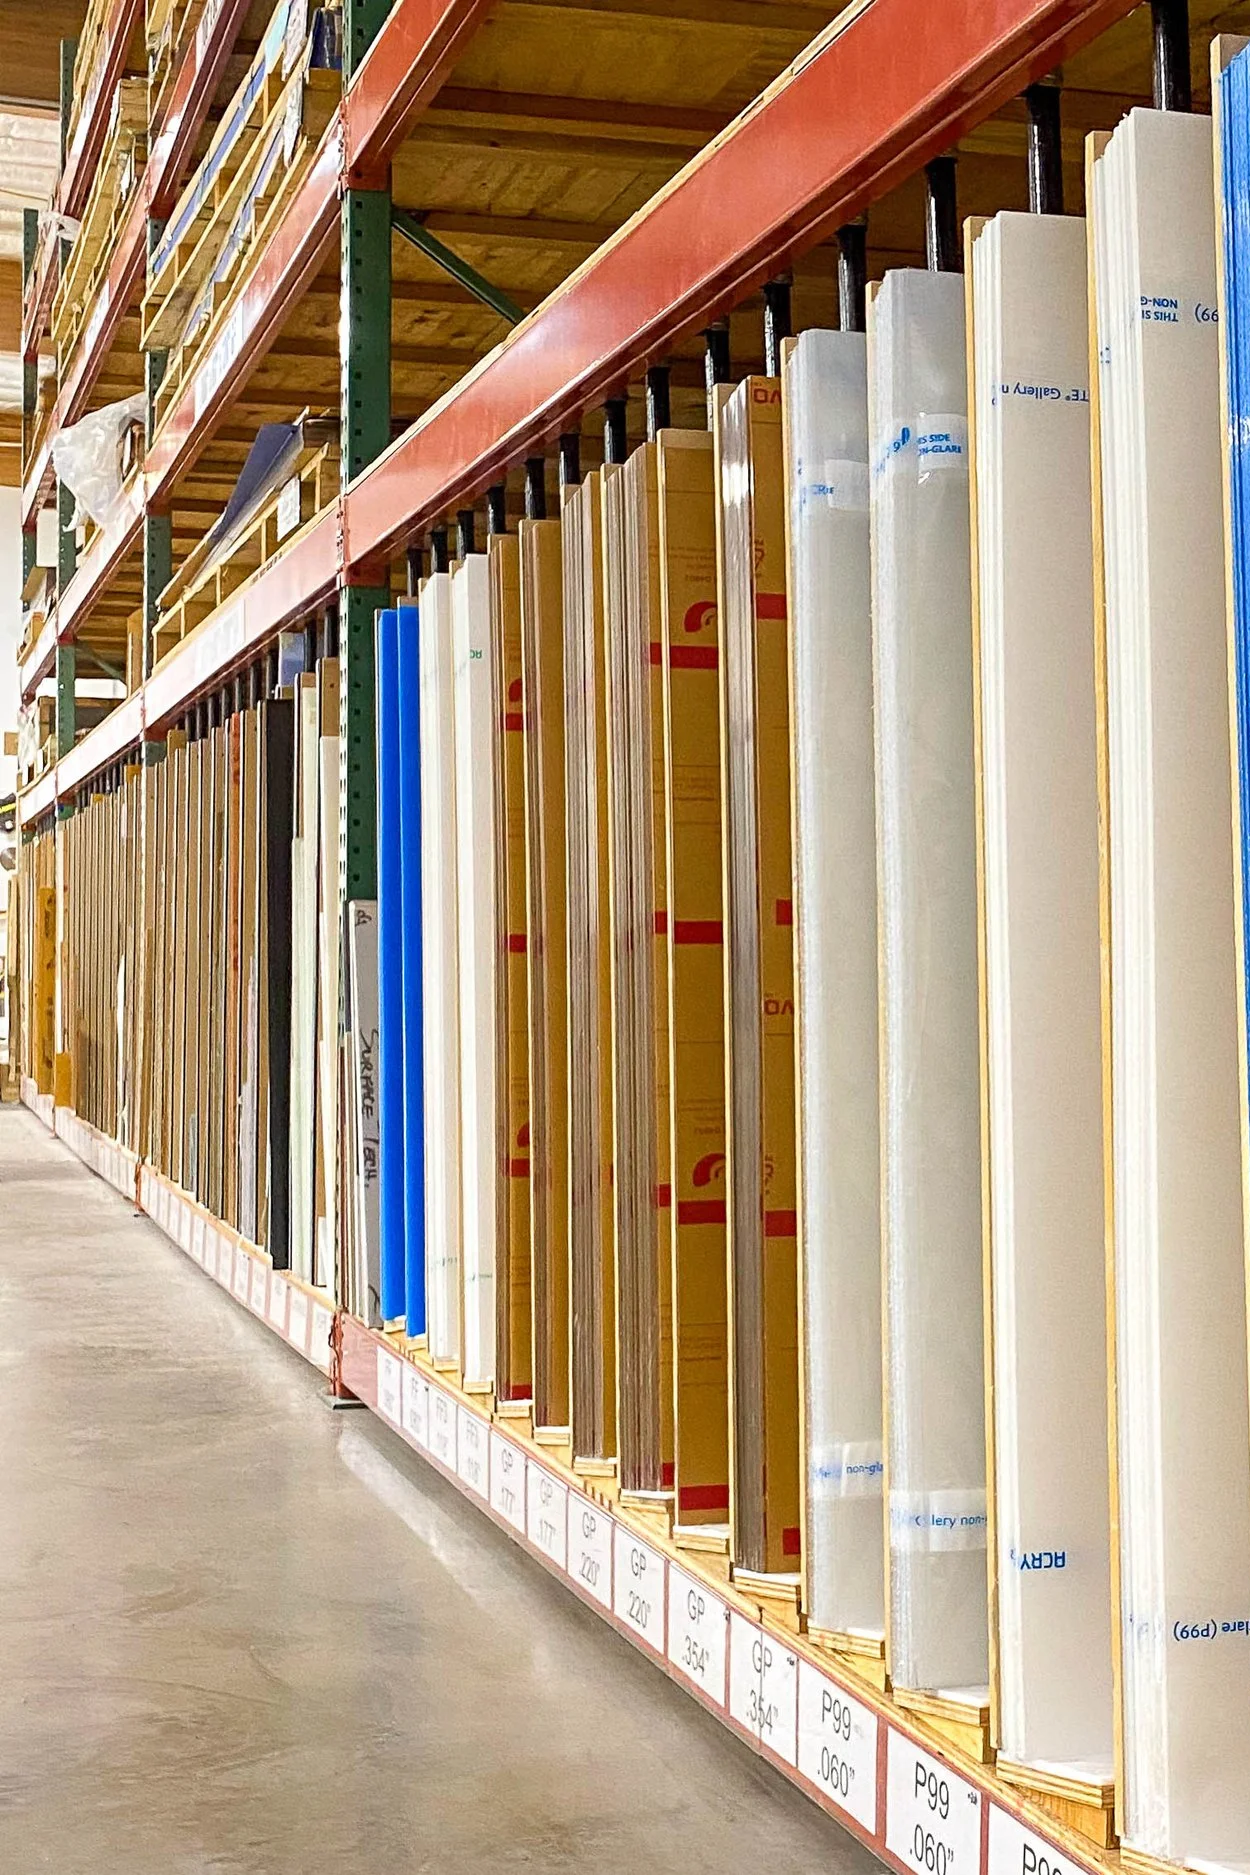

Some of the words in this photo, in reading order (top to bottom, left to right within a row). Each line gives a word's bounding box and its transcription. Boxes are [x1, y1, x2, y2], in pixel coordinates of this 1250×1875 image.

[1154, 311, 1179, 322] THIS
[1014, 383, 1060, 399] Gallery
[929, 433, 951, 443] SIDE
[501, 1447, 513, 1474] GP
[540, 1478, 553, 1507] GP
[582, 1511, 597, 1541] GP
[631, 1548, 647, 1580] GP
[1020, 1551, 1065, 1570] ACRY
[687, 1589, 705, 1624] GP
[1173, 1619, 1217, 1641] (P99)
[752, 1640, 773, 1677] GP
[822, 1690, 851, 1741] P99
[817, 1747, 855, 1798] .060"
[915, 1761, 949, 1819] P99
